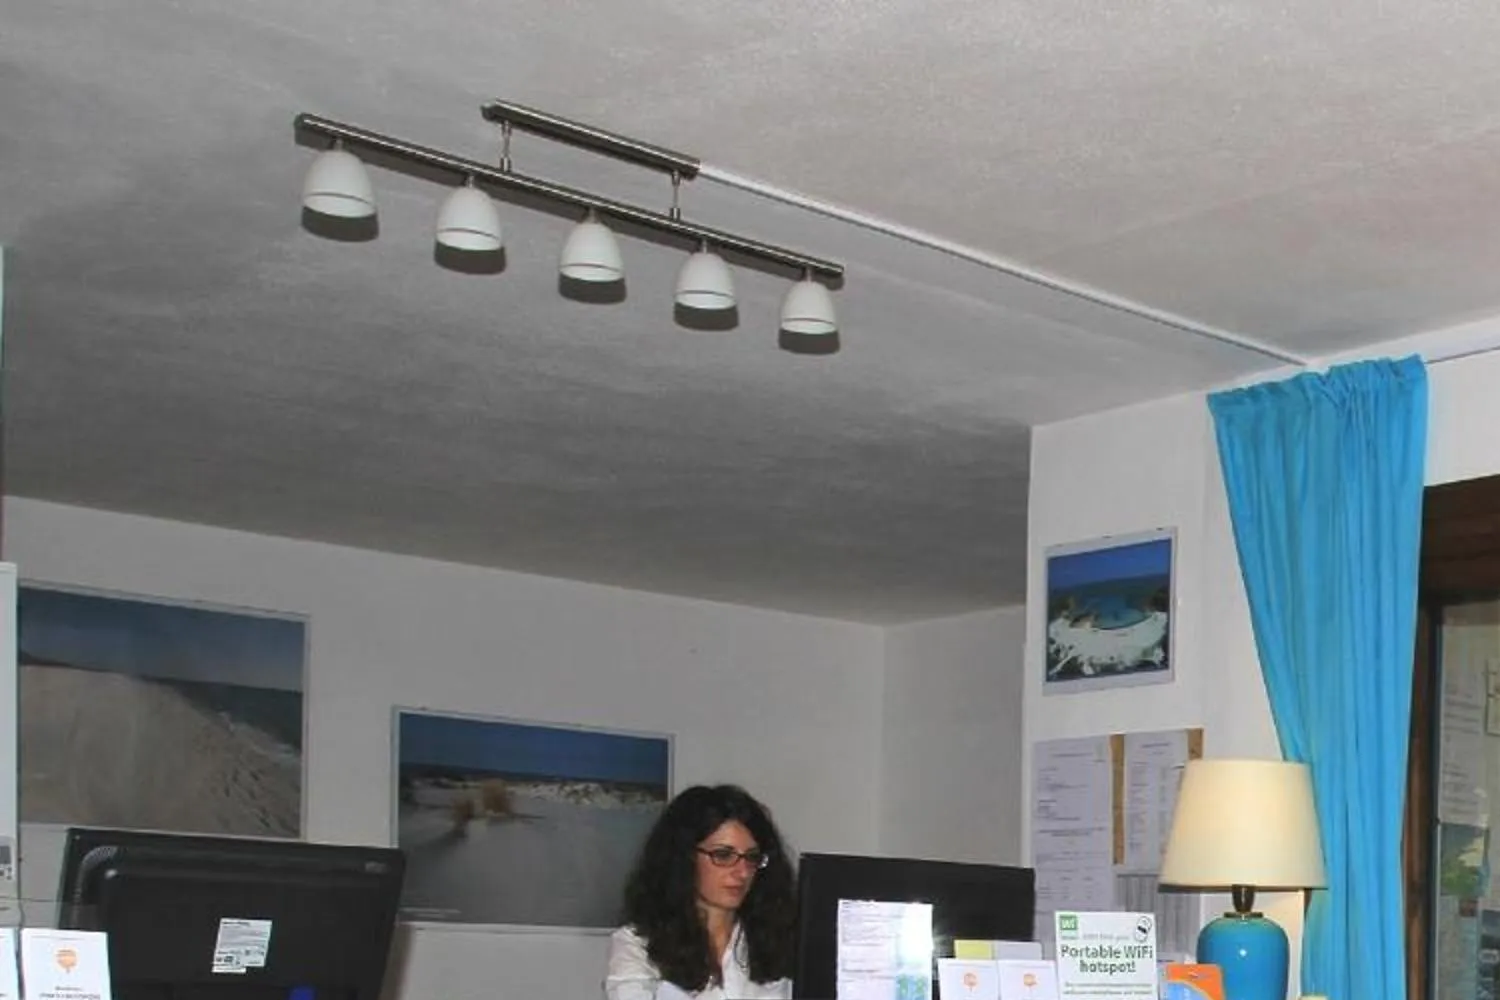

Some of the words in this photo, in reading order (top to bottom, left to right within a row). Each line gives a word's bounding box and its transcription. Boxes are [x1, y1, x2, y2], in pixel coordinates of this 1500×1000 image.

[1060, 944, 1122, 959] Portable
[1123, 945, 1153, 959] WiFi
[1079, 960, 1137, 976] hotspot!
